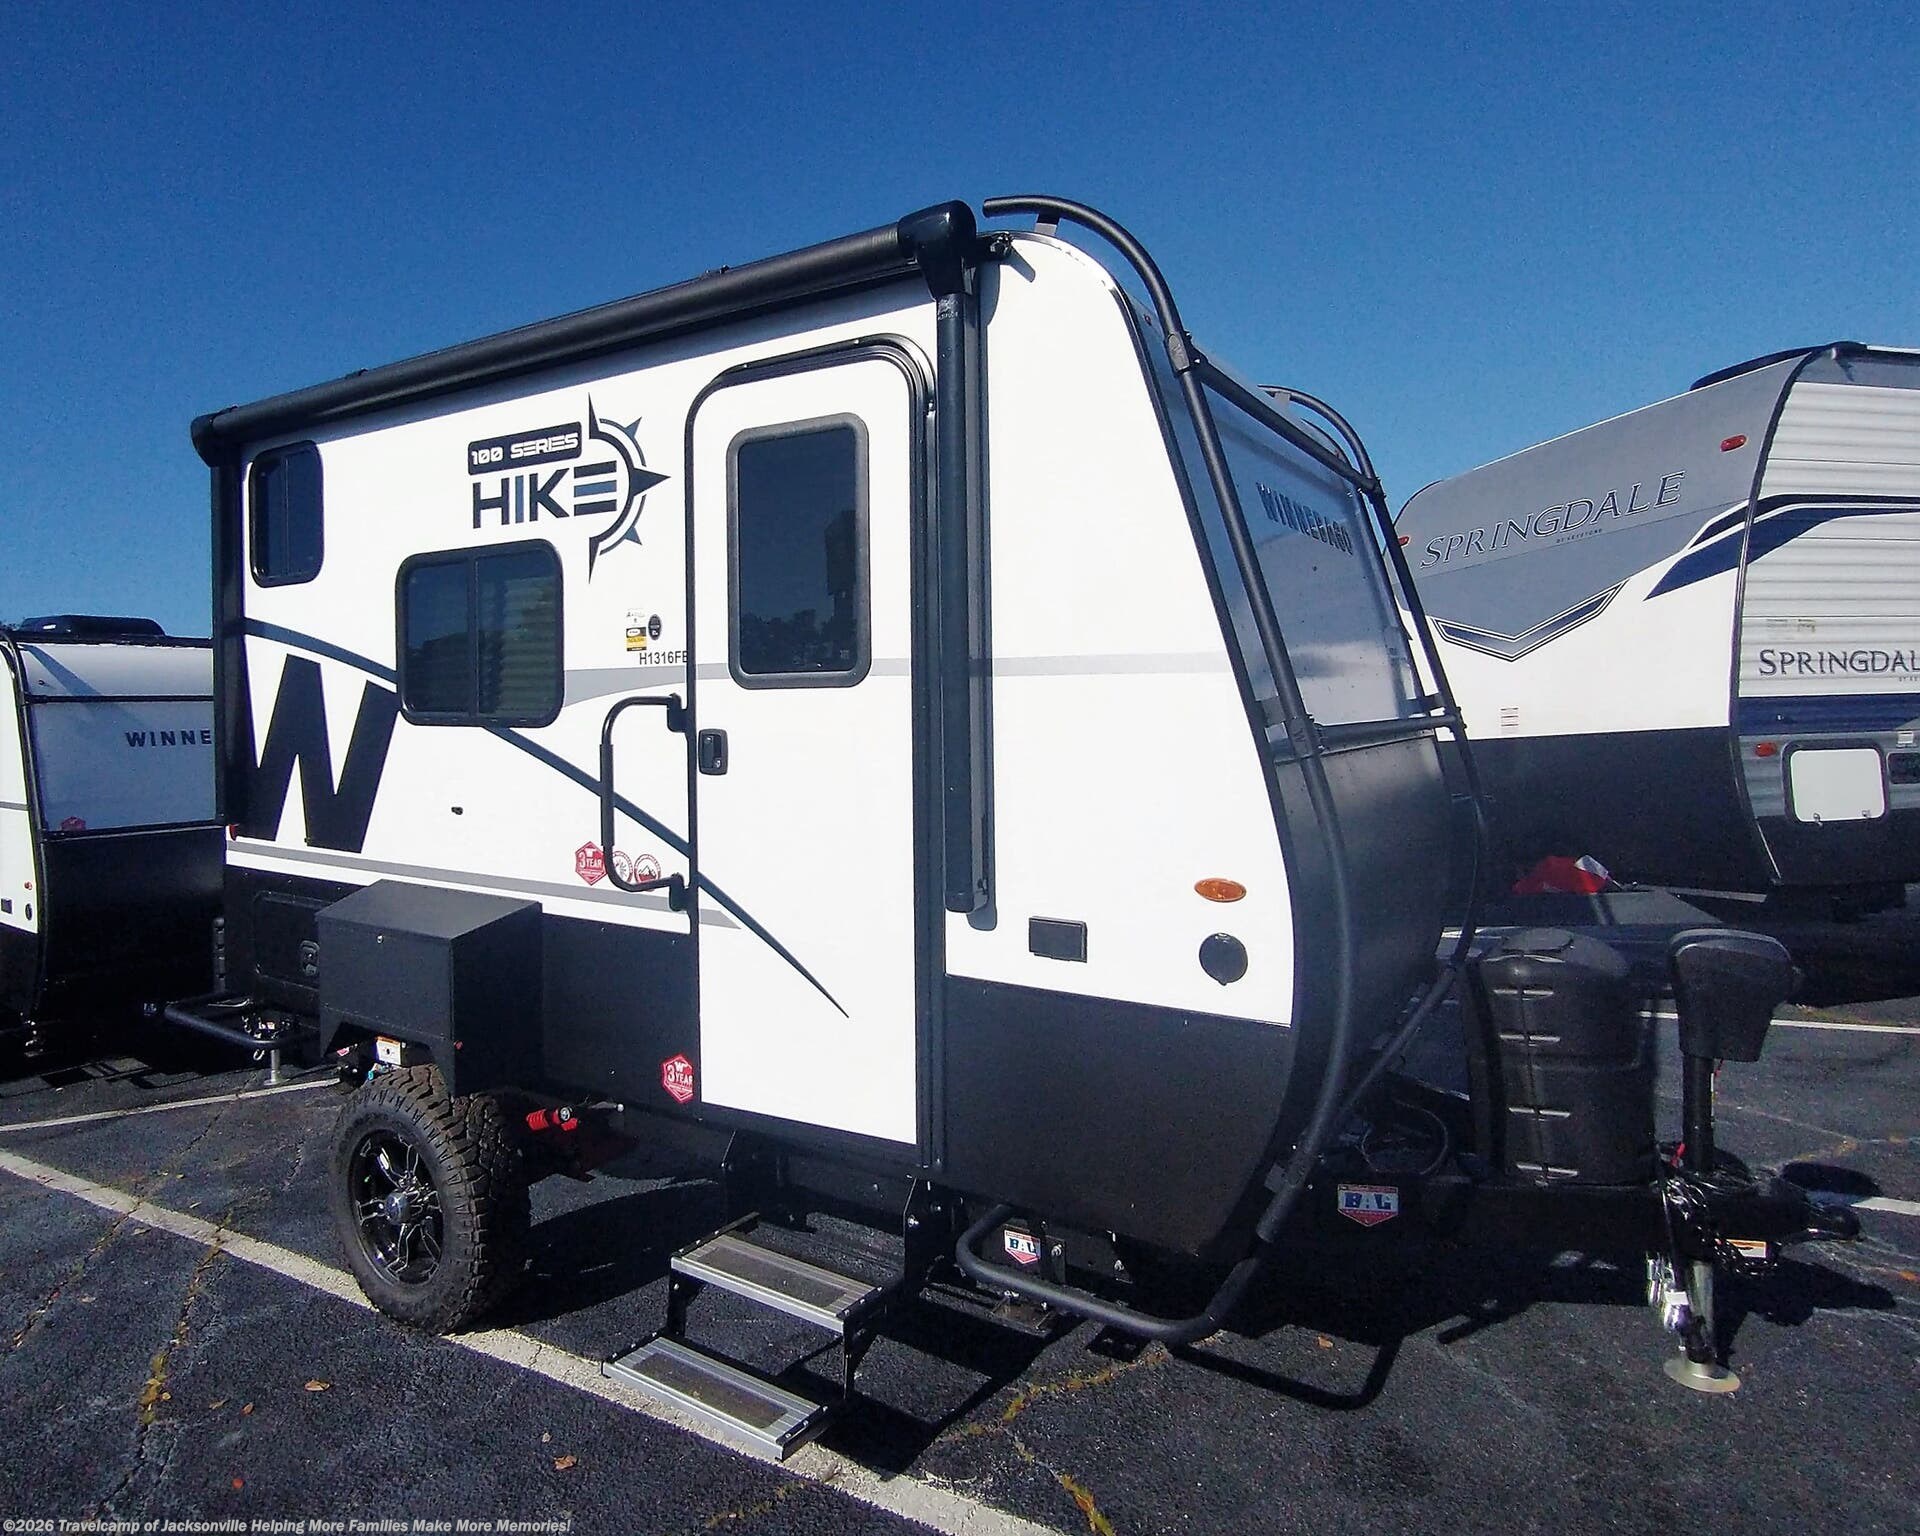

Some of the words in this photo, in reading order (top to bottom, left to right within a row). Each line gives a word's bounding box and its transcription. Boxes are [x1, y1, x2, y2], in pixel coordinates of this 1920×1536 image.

[472, 448, 503, 465] 100
[511, 433, 579, 458] SERIES
[473, 461, 617, 529] HIKE
[1420, 470, 1686, 569] SPRINGDALE
[1759, 650, 1920, 676] SPRINGDAL
[125, 730, 212, 747] WINNE
[578, 851, 586, 868] 3
[667, 1064, 675, 1082] 3
